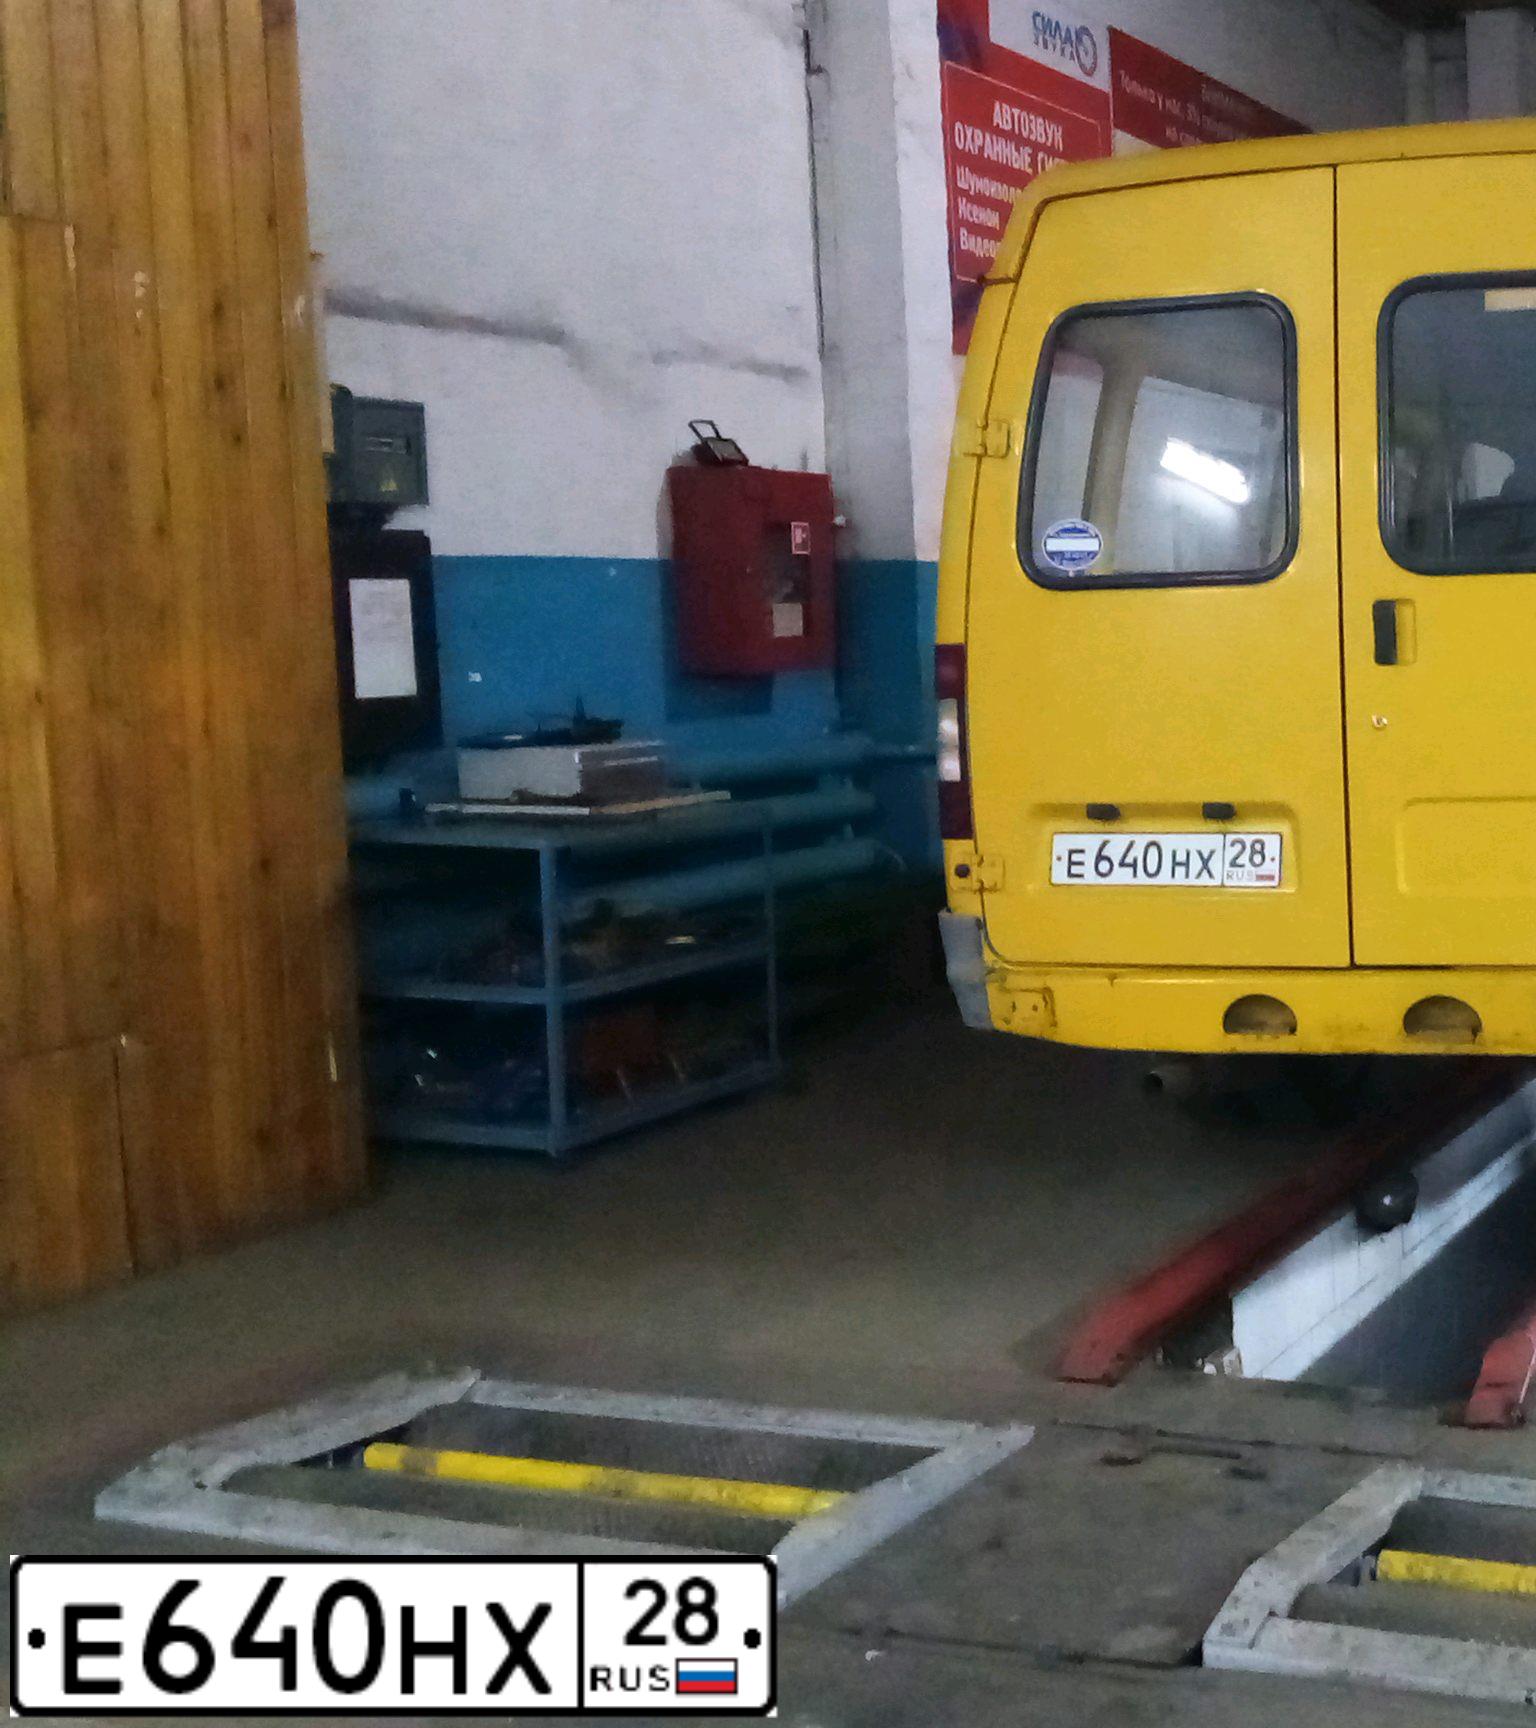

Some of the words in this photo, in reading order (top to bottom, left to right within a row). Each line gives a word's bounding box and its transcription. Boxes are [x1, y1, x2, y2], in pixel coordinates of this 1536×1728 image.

[993, 101, 1064, 152] АВТОЗВУК
[954, 121, 1034, 175] ОХРАННЫЕ
[958, 196, 1000, 231] Ксенон
[959, 226, 1001, 258] Видео
[1066, 839, 1216, 880] Е640НХ
[1228, 838, 1266, 868] 28
[1226, 870, 1254, 882] RUS
